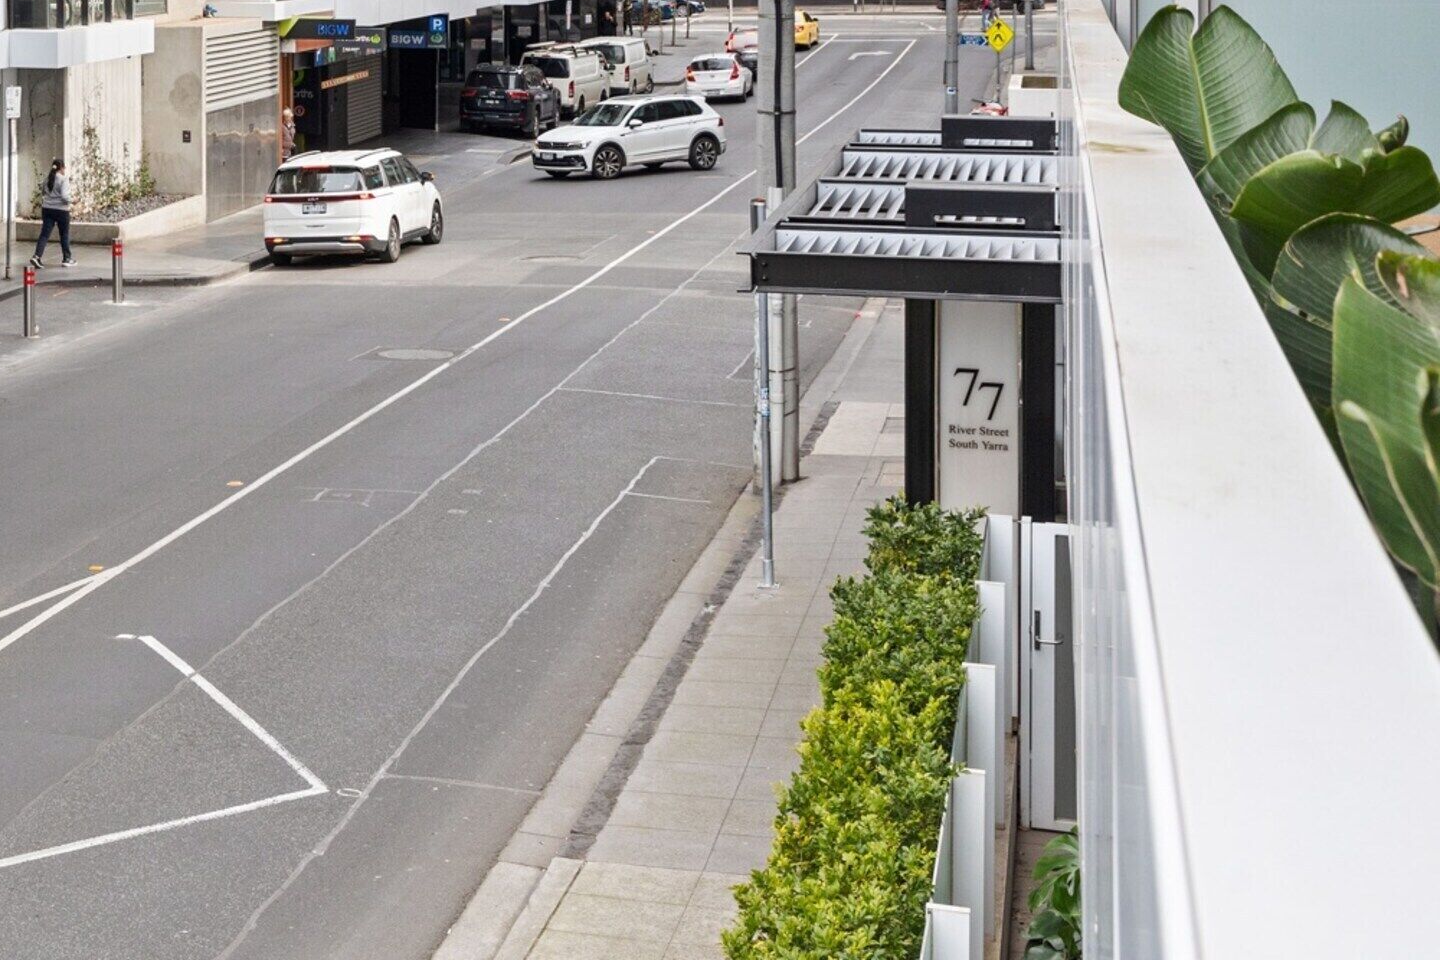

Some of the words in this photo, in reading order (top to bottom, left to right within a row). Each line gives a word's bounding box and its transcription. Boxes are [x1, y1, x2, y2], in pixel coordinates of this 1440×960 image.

[953, 367, 1005, 421] 77
[948, 424, 976, 435] River
[979, 426, 1009, 437] Street
[948, 438, 978, 449] South
[982, 440, 1009, 451] Yarra
